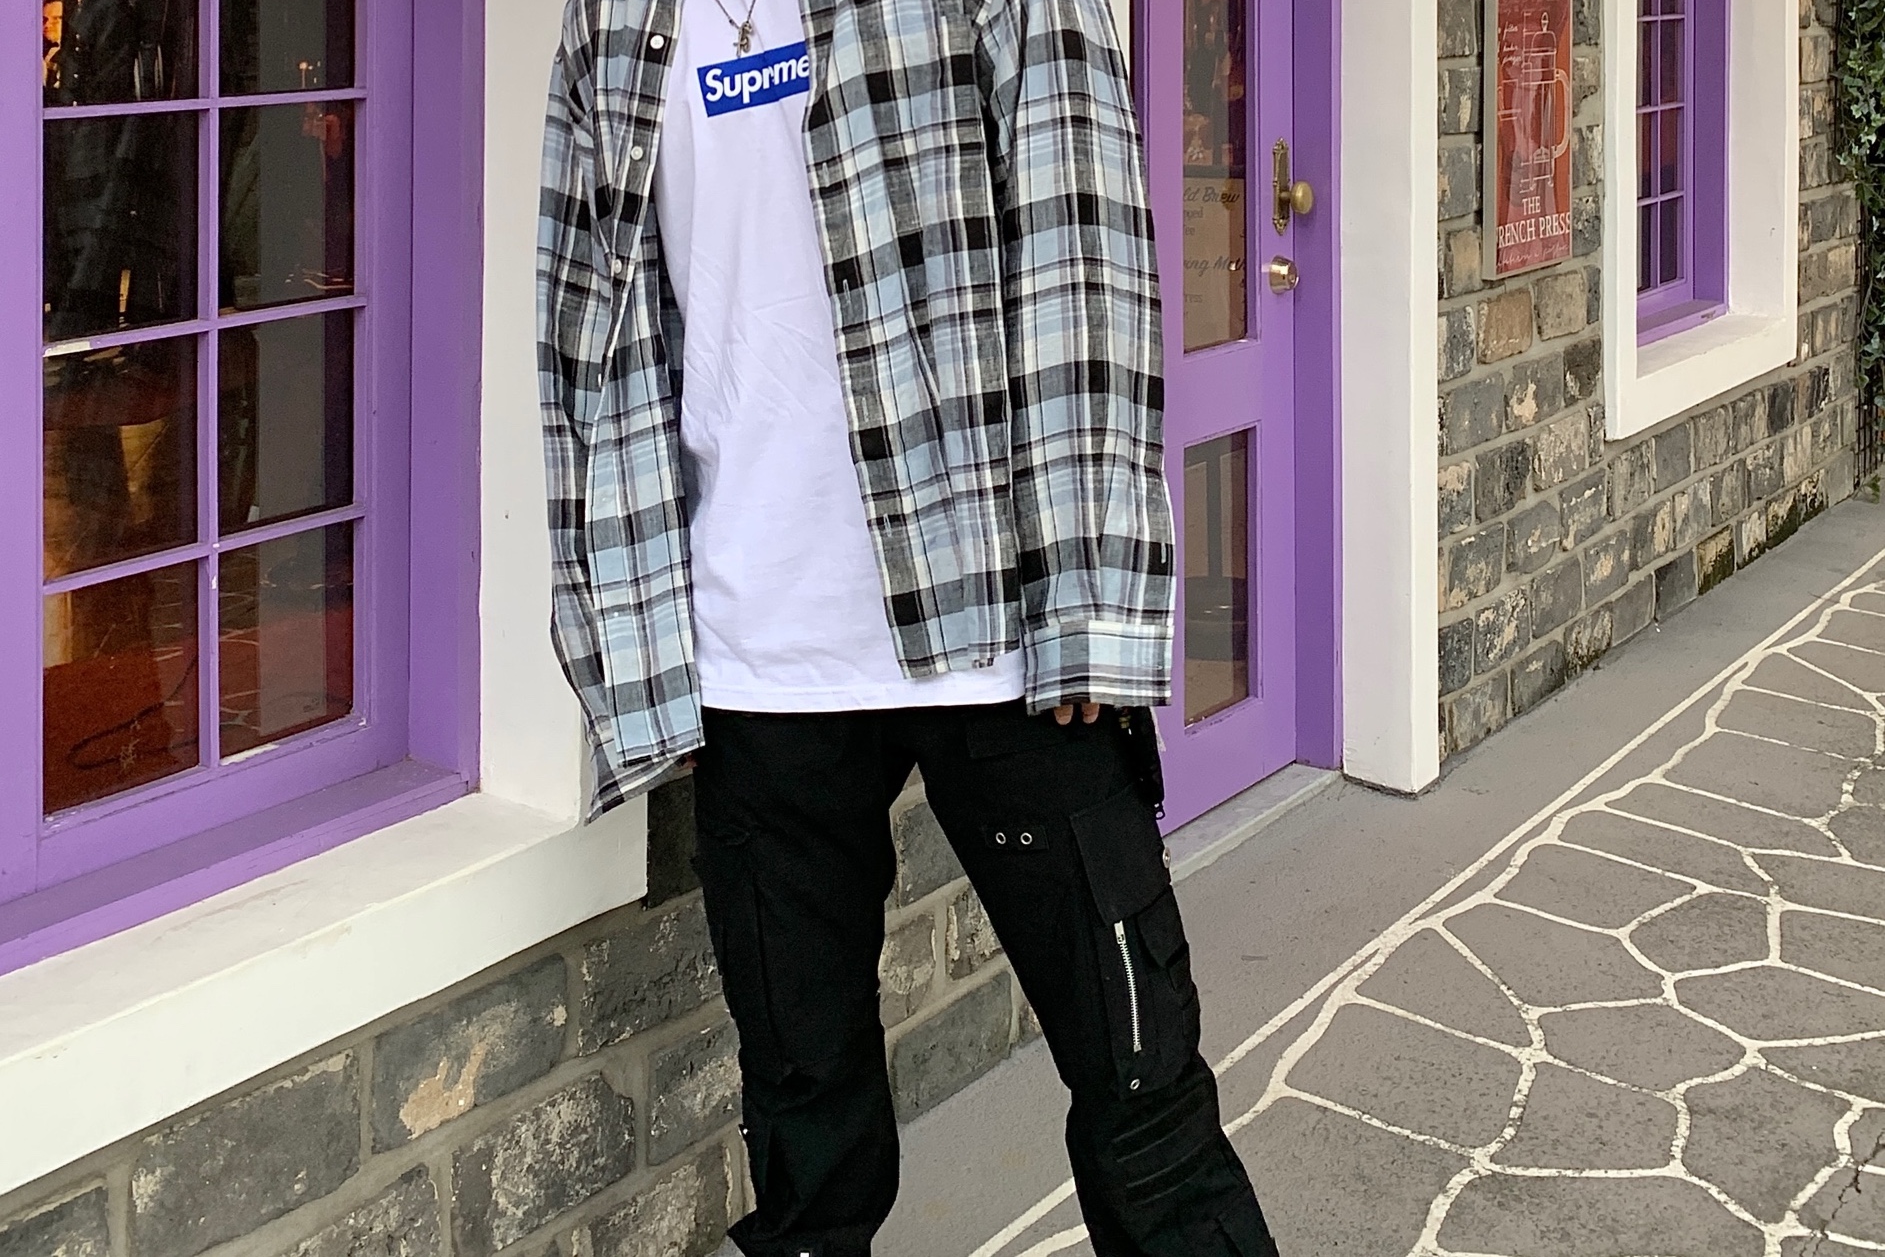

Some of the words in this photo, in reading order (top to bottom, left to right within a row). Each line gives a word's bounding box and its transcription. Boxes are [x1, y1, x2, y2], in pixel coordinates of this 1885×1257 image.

[1522, 196, 1541, 216] THE
[1496, 218, 1536, 248] RENCH
[1539, 211, 1571, 239] PRESS
